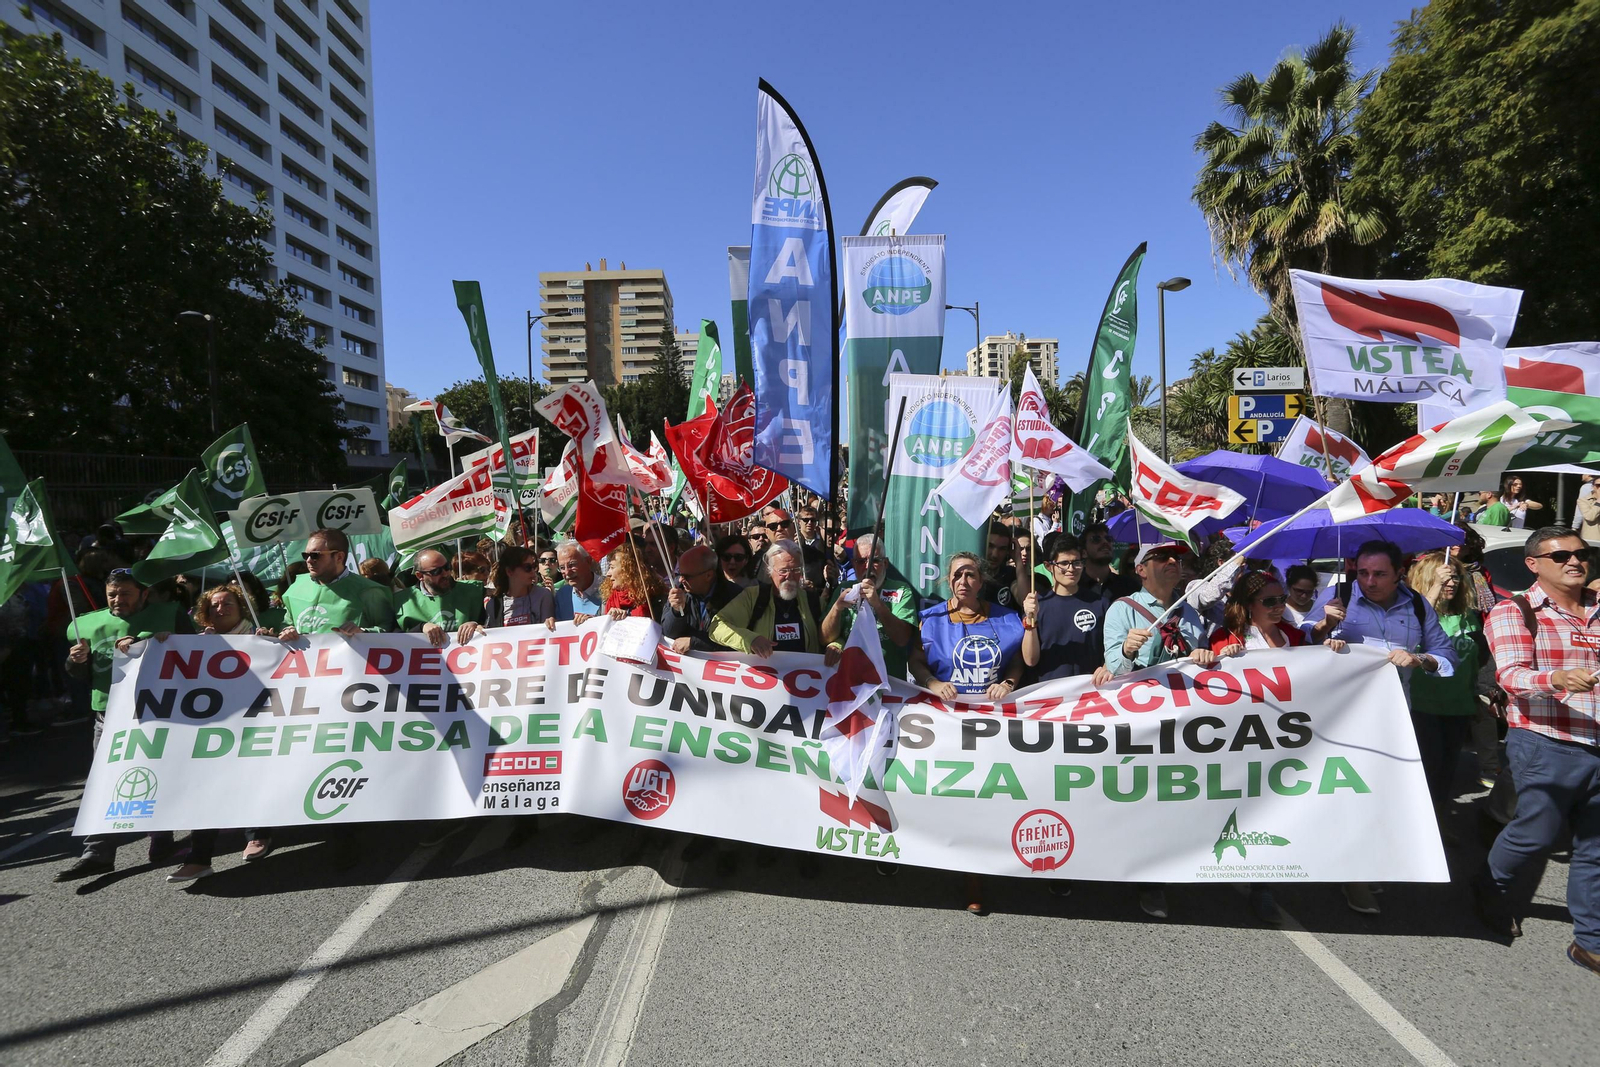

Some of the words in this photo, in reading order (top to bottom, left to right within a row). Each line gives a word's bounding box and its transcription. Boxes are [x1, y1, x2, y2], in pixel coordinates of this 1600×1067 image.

[860, 250, 886, 277] SINDICATO
[887, 249, 932, 275] INDEPENDIENTE
[872, 289, 922, 304] ANPE
[1346, 345, 1473, 385] USTEA
[1267, 373, 1291, 381] Larios
[904, 393, 932, 422] SINDICATO
[933, 392, 978, 425] INDEPENDIENTE
[1239, 396, 1256, 419] P
[1258, 420, 1274, 442] P
[912, 437, 964, 456] ANPE
[159, 650, 252, 680] NO
[270, 648, 343, 679] AL
[364, 631, 598, 676] DECRETO
[949, 666, 1001, 684] ANPE
[133, 687, 223, 719] NO
[243, 686, 320, 718] AL
[341, 675, 546, 713] CIERRE
[568, 667, 609, 704] DE
[107, 727, 169, 764] EN
[191, 719, 471, 758] DEFENSA
[487, 713, 561, 747] DE
[1054, 756, 1373, 802] PÚBLICA
[488, 757, 540, 771] CCOO
[317, 778, 369, 799] CSIF
[482, 779, 561, 793] enseñanza
[629, 768, 671, 795] UGT
[105, 800, 156, 816] ANPE
[816, 826, 900, 859] USTEA
[1019, 823, 1063, 842] FRENTE
[1021, 841, 1069, 854] ESTUDIANTES
